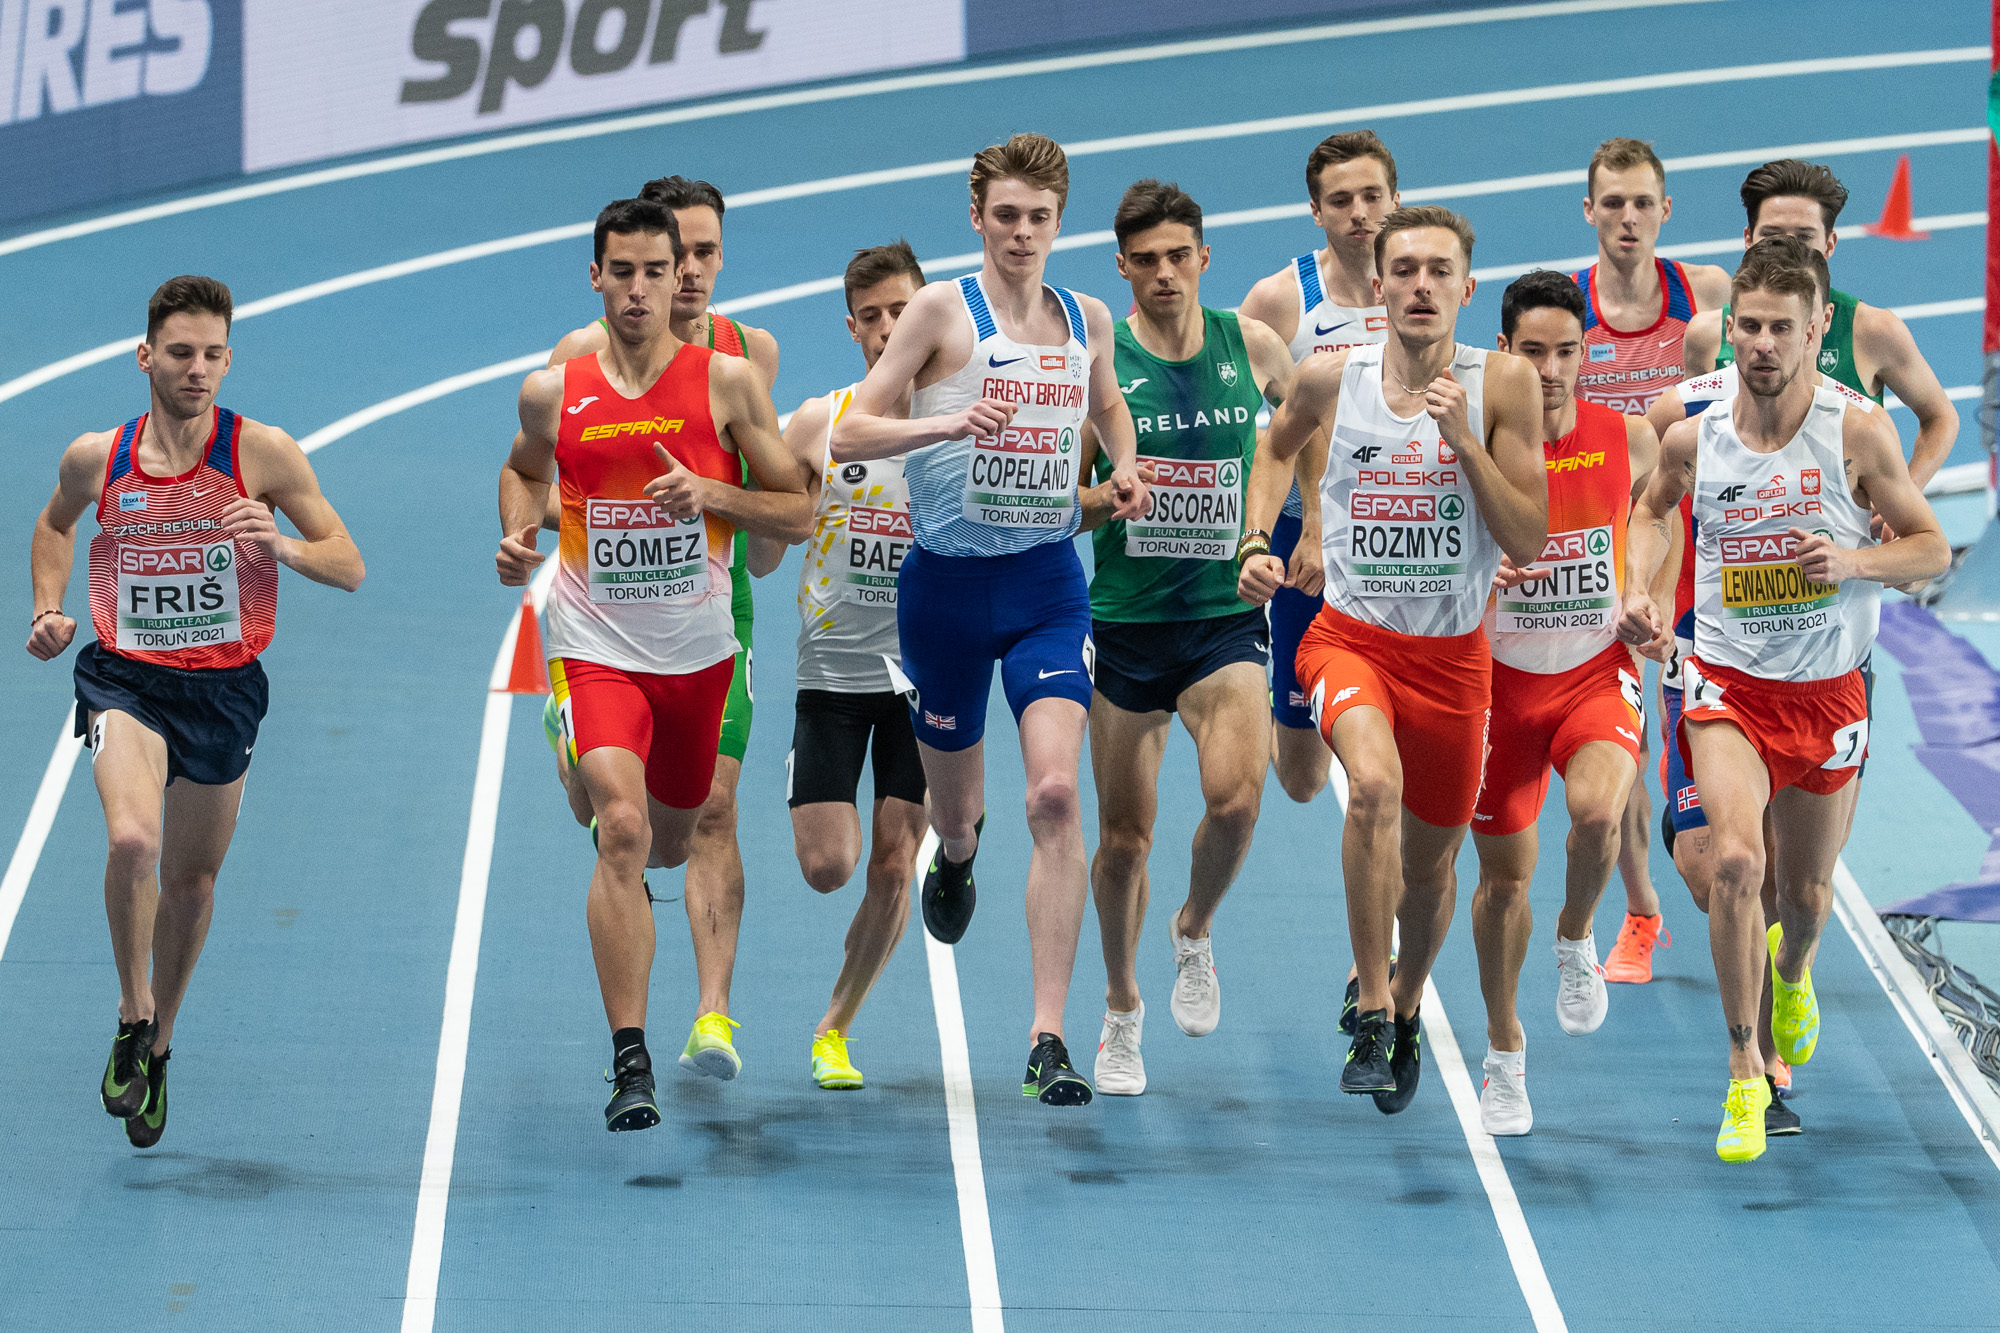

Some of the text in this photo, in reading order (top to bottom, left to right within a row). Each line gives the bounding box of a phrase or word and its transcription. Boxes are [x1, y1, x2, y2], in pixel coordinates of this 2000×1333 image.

[1580, 365, 1685, 386] CZECH REPUBL
[982, 377, 1085, 408] GREAT BRITAIN
[579, 416, 686, 442] ESPAÑA
[1137, 406, 1249, 434] RELAND
[1352, 446, 1382, 463] 4F
[1392, 454, 1422, 464] ORLEN
[1545, 451, 1606, 473] PAÑA
[972, 453, 1069, 491] COPELAND
[1138, 462, 1215, 484] PAR
[1358, 470, 1458, 486] POLSKA
[996, 495, 1019, 505] RUN
[1717, 485, 1747, 502] 4F
[1757, 487, 1786, 499] ORLEN
[980, 508, 1062, 524] TORUŃ 2021
[1144, 492, 1237, 524] OSCORAN
[1353, 497, 1434, 517] SPAR
[1724, 501, 1822, 523] POLSKA
[113, 519, 224, 537] CZECH REPUBL
[851, 510, 913, 535] SPA
[1153, 528, 1177, 537] RUN
[1352, 525, 1461, 559] ROZMYS
[594, 532, 702, 568] GÓMEZ
[850, 537, 912, 572] BAE
[1138, 540, 1191, 555] TORUŃ
[1193, 543, 1226, 555] 2021
[1541, 536, 1584, 558] AR
[121, 551, 202, 572] SPAR
[1376, 566, 1400, 574] RUN
[619, 571, 644, 582] RUN
[871, 576, 895, 586] RUN
[1362, 578, 1452, 593] TORUŃ 2021
[1503, 560, 1609, 598] ONTES
[130, 576, 225, 614] FRIŠ
[605, 580, 695, 600] TORUŃ 2021
[856, 588, 898, 603] TORU
[1529, 602, 1551, 612] RUN
[1752, 606, 1777, 616] RUN
[147, 618, 171, 629] RUN
[1513, 613, 1603, 629] TORUŃ 2021
[1740, 612, 1828, 635] TORUŃ 2021
[134, 628, 226, 647] TORUŃ 2021
